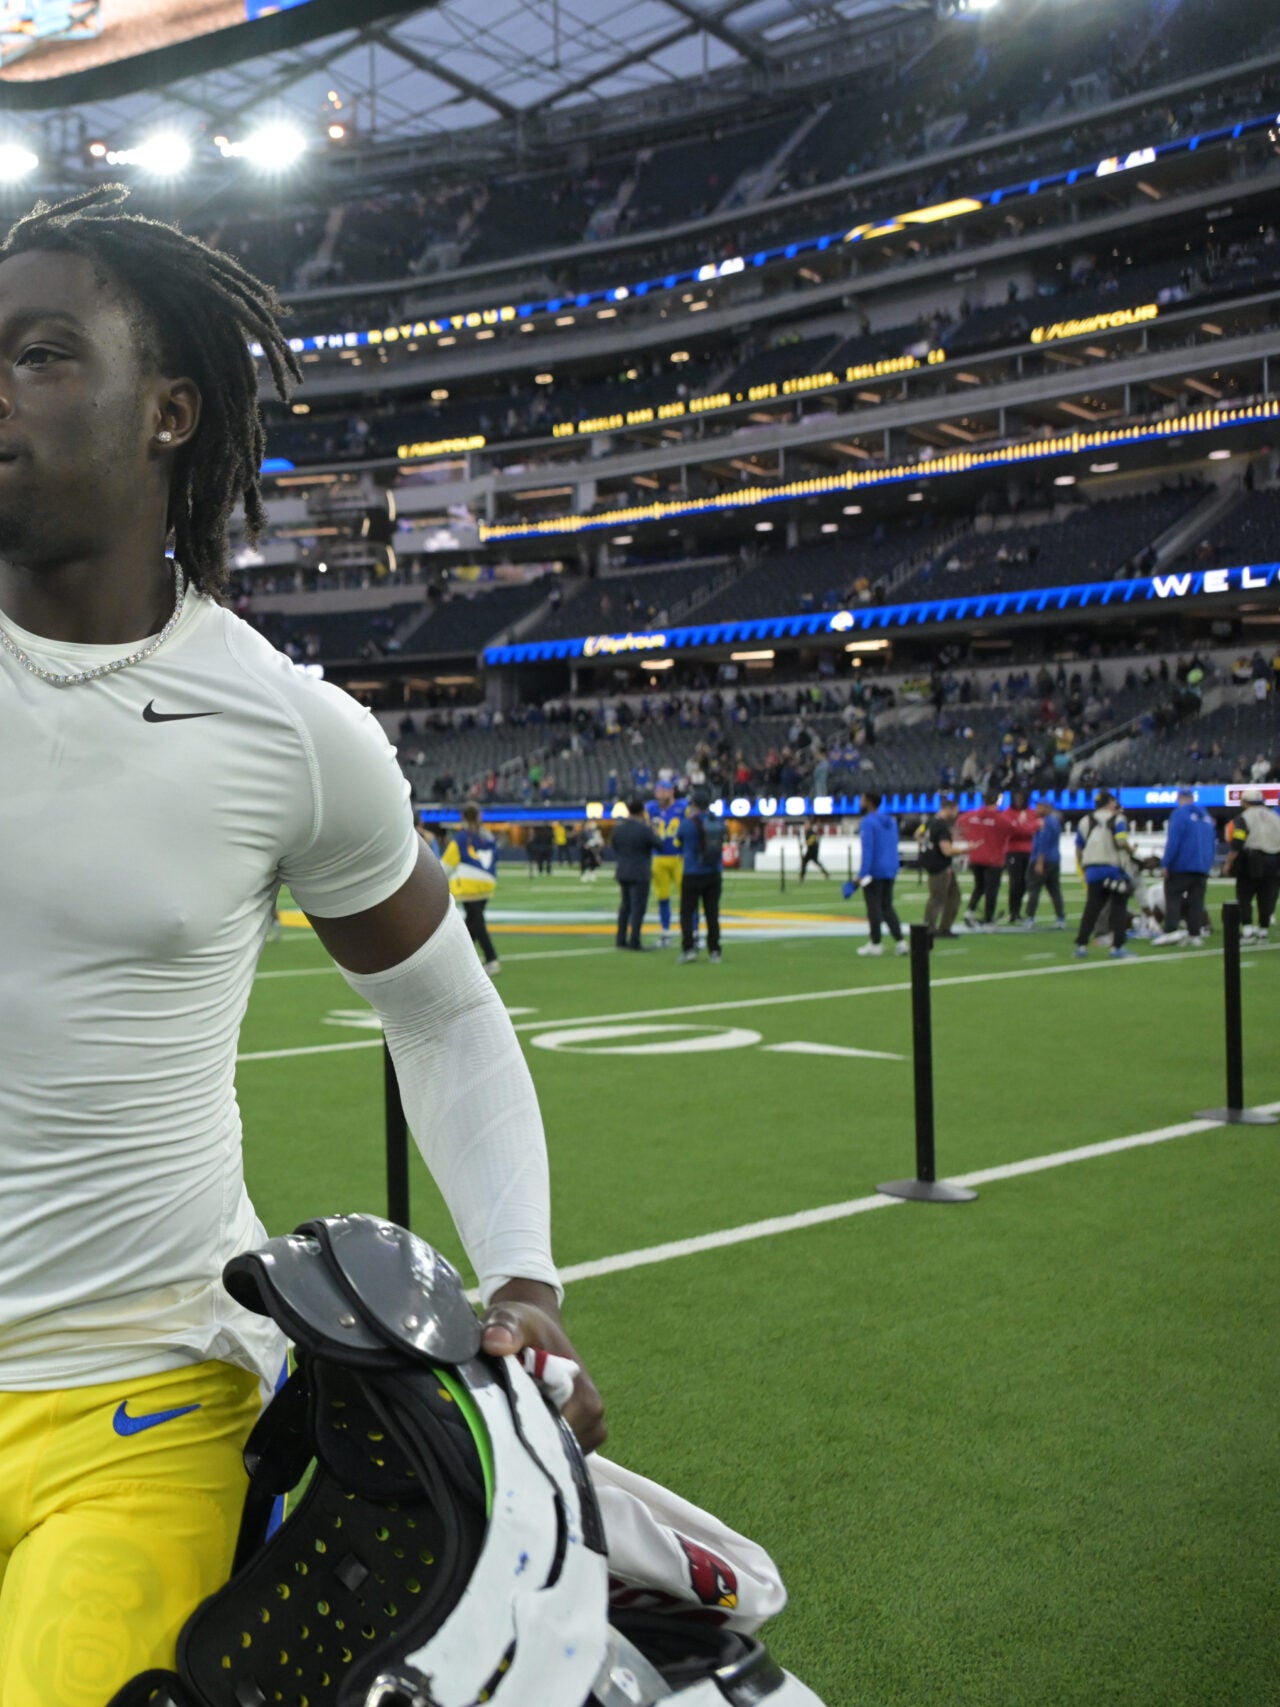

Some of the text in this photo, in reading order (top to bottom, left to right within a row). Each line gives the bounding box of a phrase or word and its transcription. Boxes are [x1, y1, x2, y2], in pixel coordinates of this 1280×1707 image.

[313, 331, 358, 349] THE
[367, 319, 442, 344] ROYAL
[450, 305, 516, 330] TOUR
[1152, 565, 1280, 599] WEL
[586, 800, 630, 819] RA
